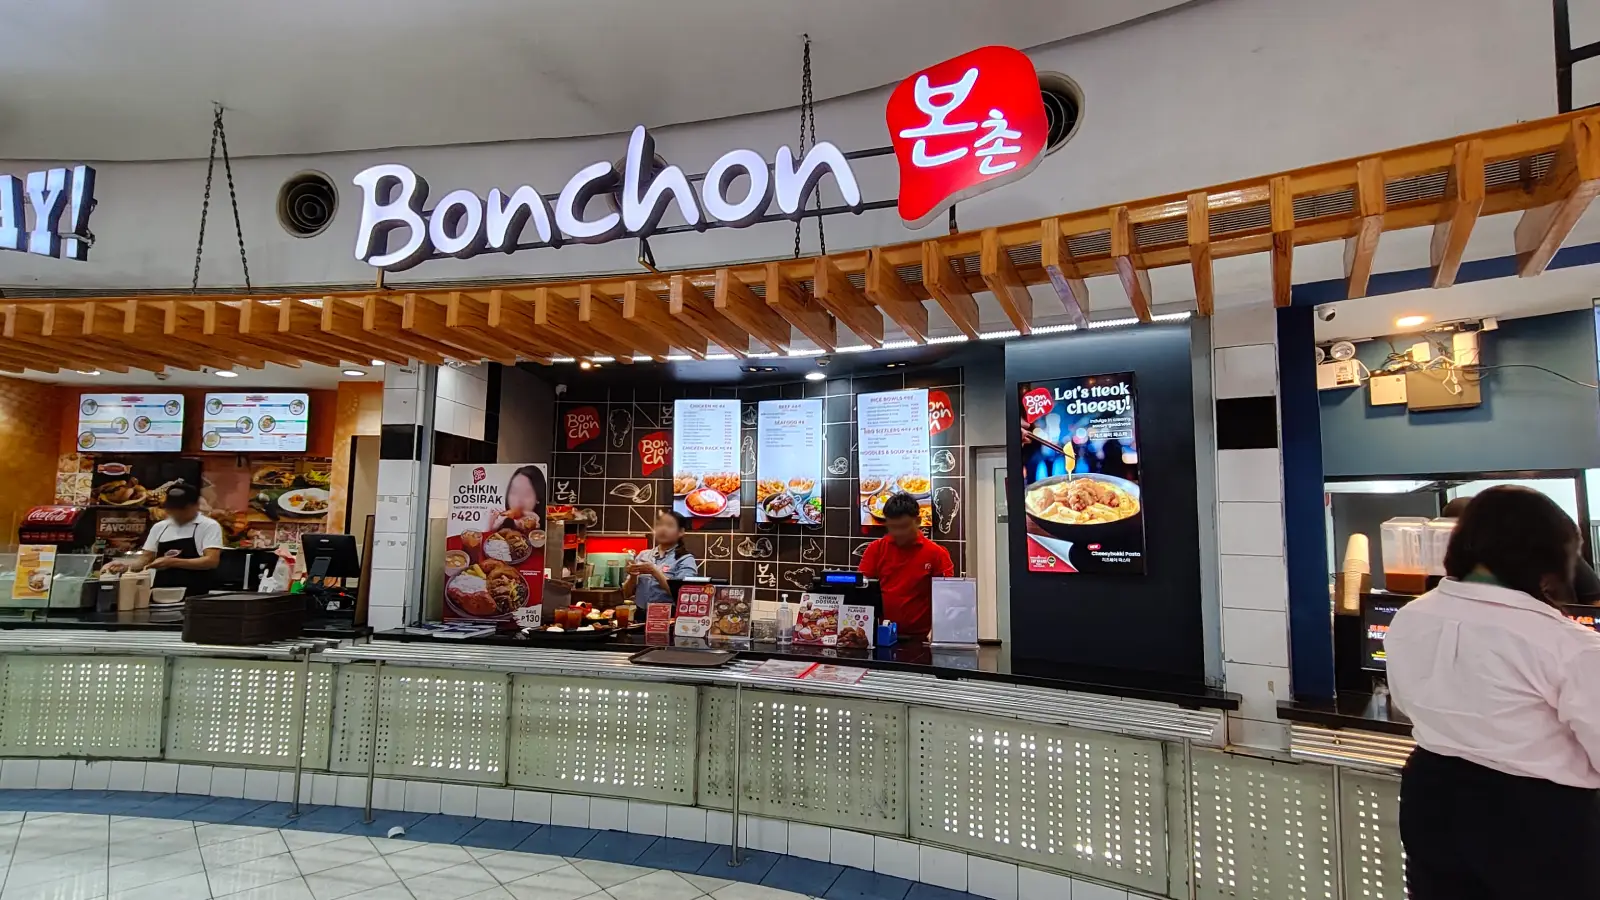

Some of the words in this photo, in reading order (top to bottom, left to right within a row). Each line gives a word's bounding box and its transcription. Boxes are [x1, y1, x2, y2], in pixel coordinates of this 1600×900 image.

[899, 68, 1022, 175] 본촌
[352, 124, 863, 268] Bonchon
[1054, 385, 1090, 401] Let's
[1066, 395, 1132, 415] cheesy!
[458, 484, 498, 495] CHIKIN
[453, 494, 503, 504] DOSIRAK
